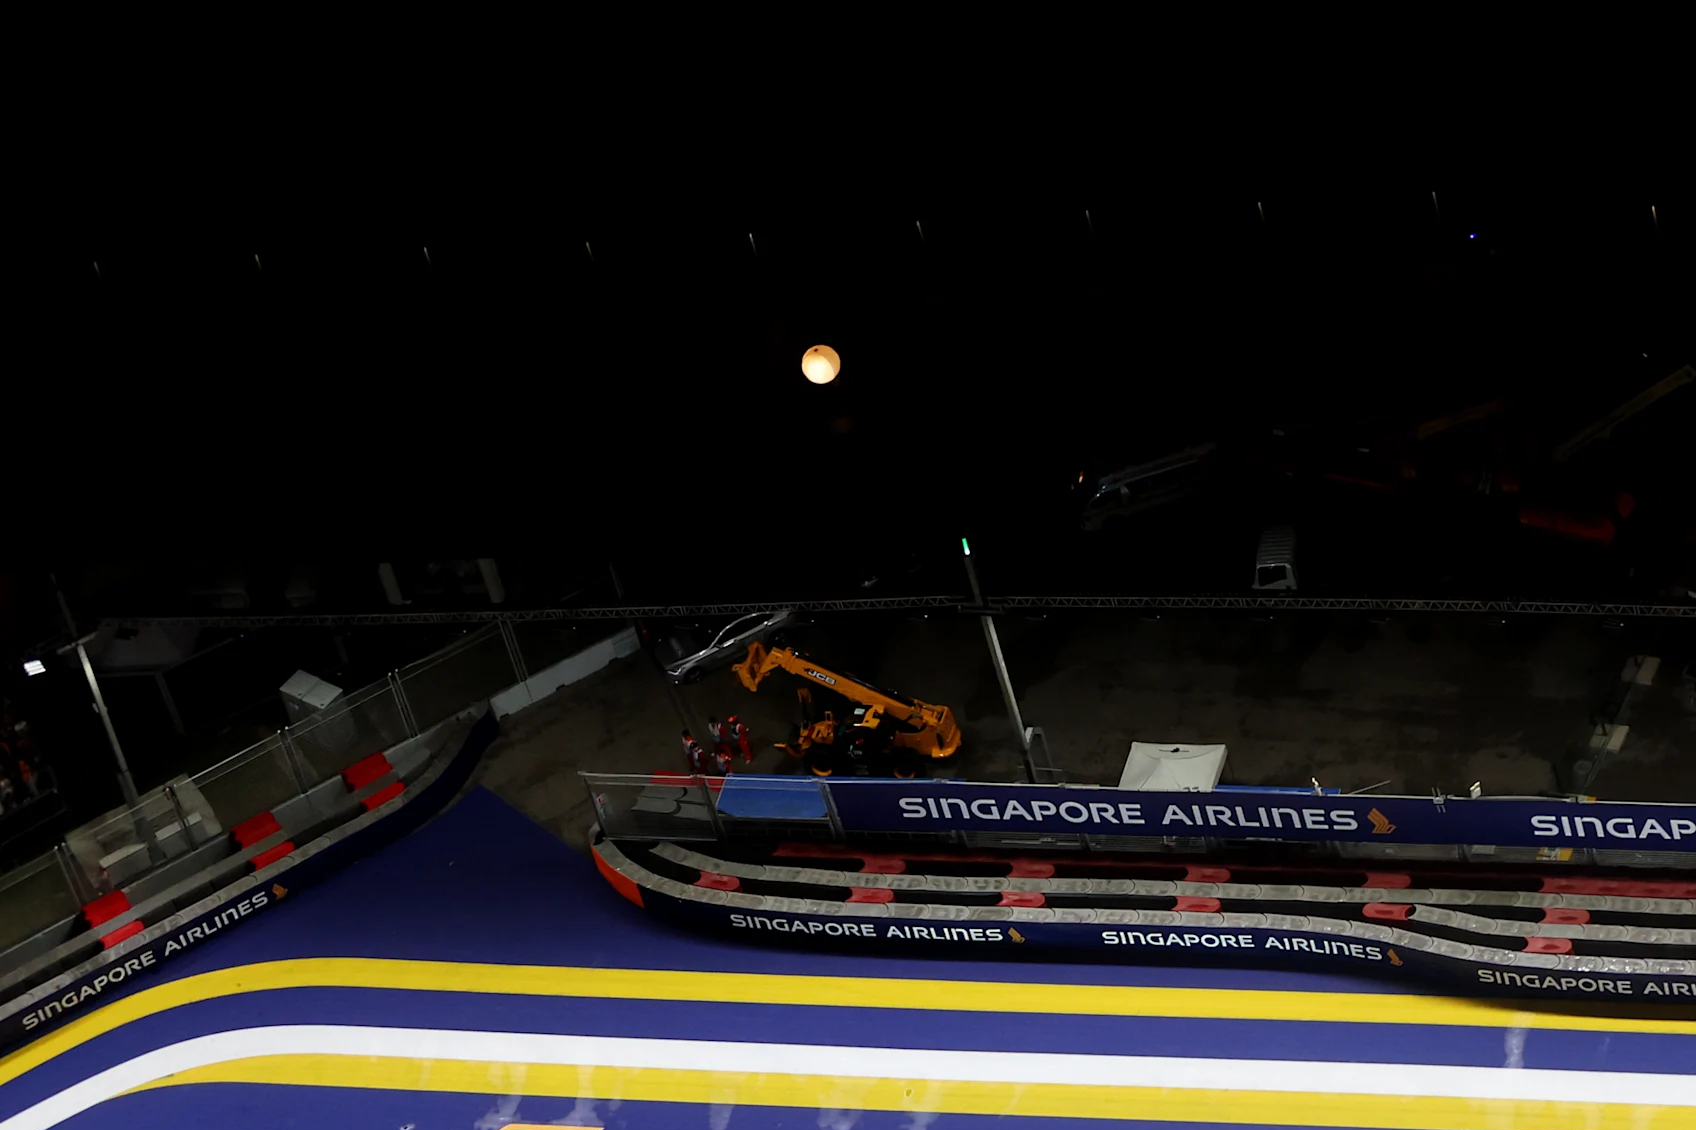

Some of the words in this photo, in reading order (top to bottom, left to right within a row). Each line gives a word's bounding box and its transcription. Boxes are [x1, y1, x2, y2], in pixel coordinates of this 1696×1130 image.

[808, 670, 836, 686] JCB
[899, 797, 1145, 825] SINGAPORE
[1162, 803, 1358, 831] AIRLINES
[729, 914, 877, 938] SINGAPORE
[886, 925, 1004, 942] AIRLINES
[22, 951, 156, 1030] SINGAPORE
[165, 891, 268, 956] AIRLINES
[1101, 931, 1256, 949] SINGAPORE
[1264, 936, 1382, 961] AIRLINES
[1477, 969, 1634, 995] SINGAPORE
